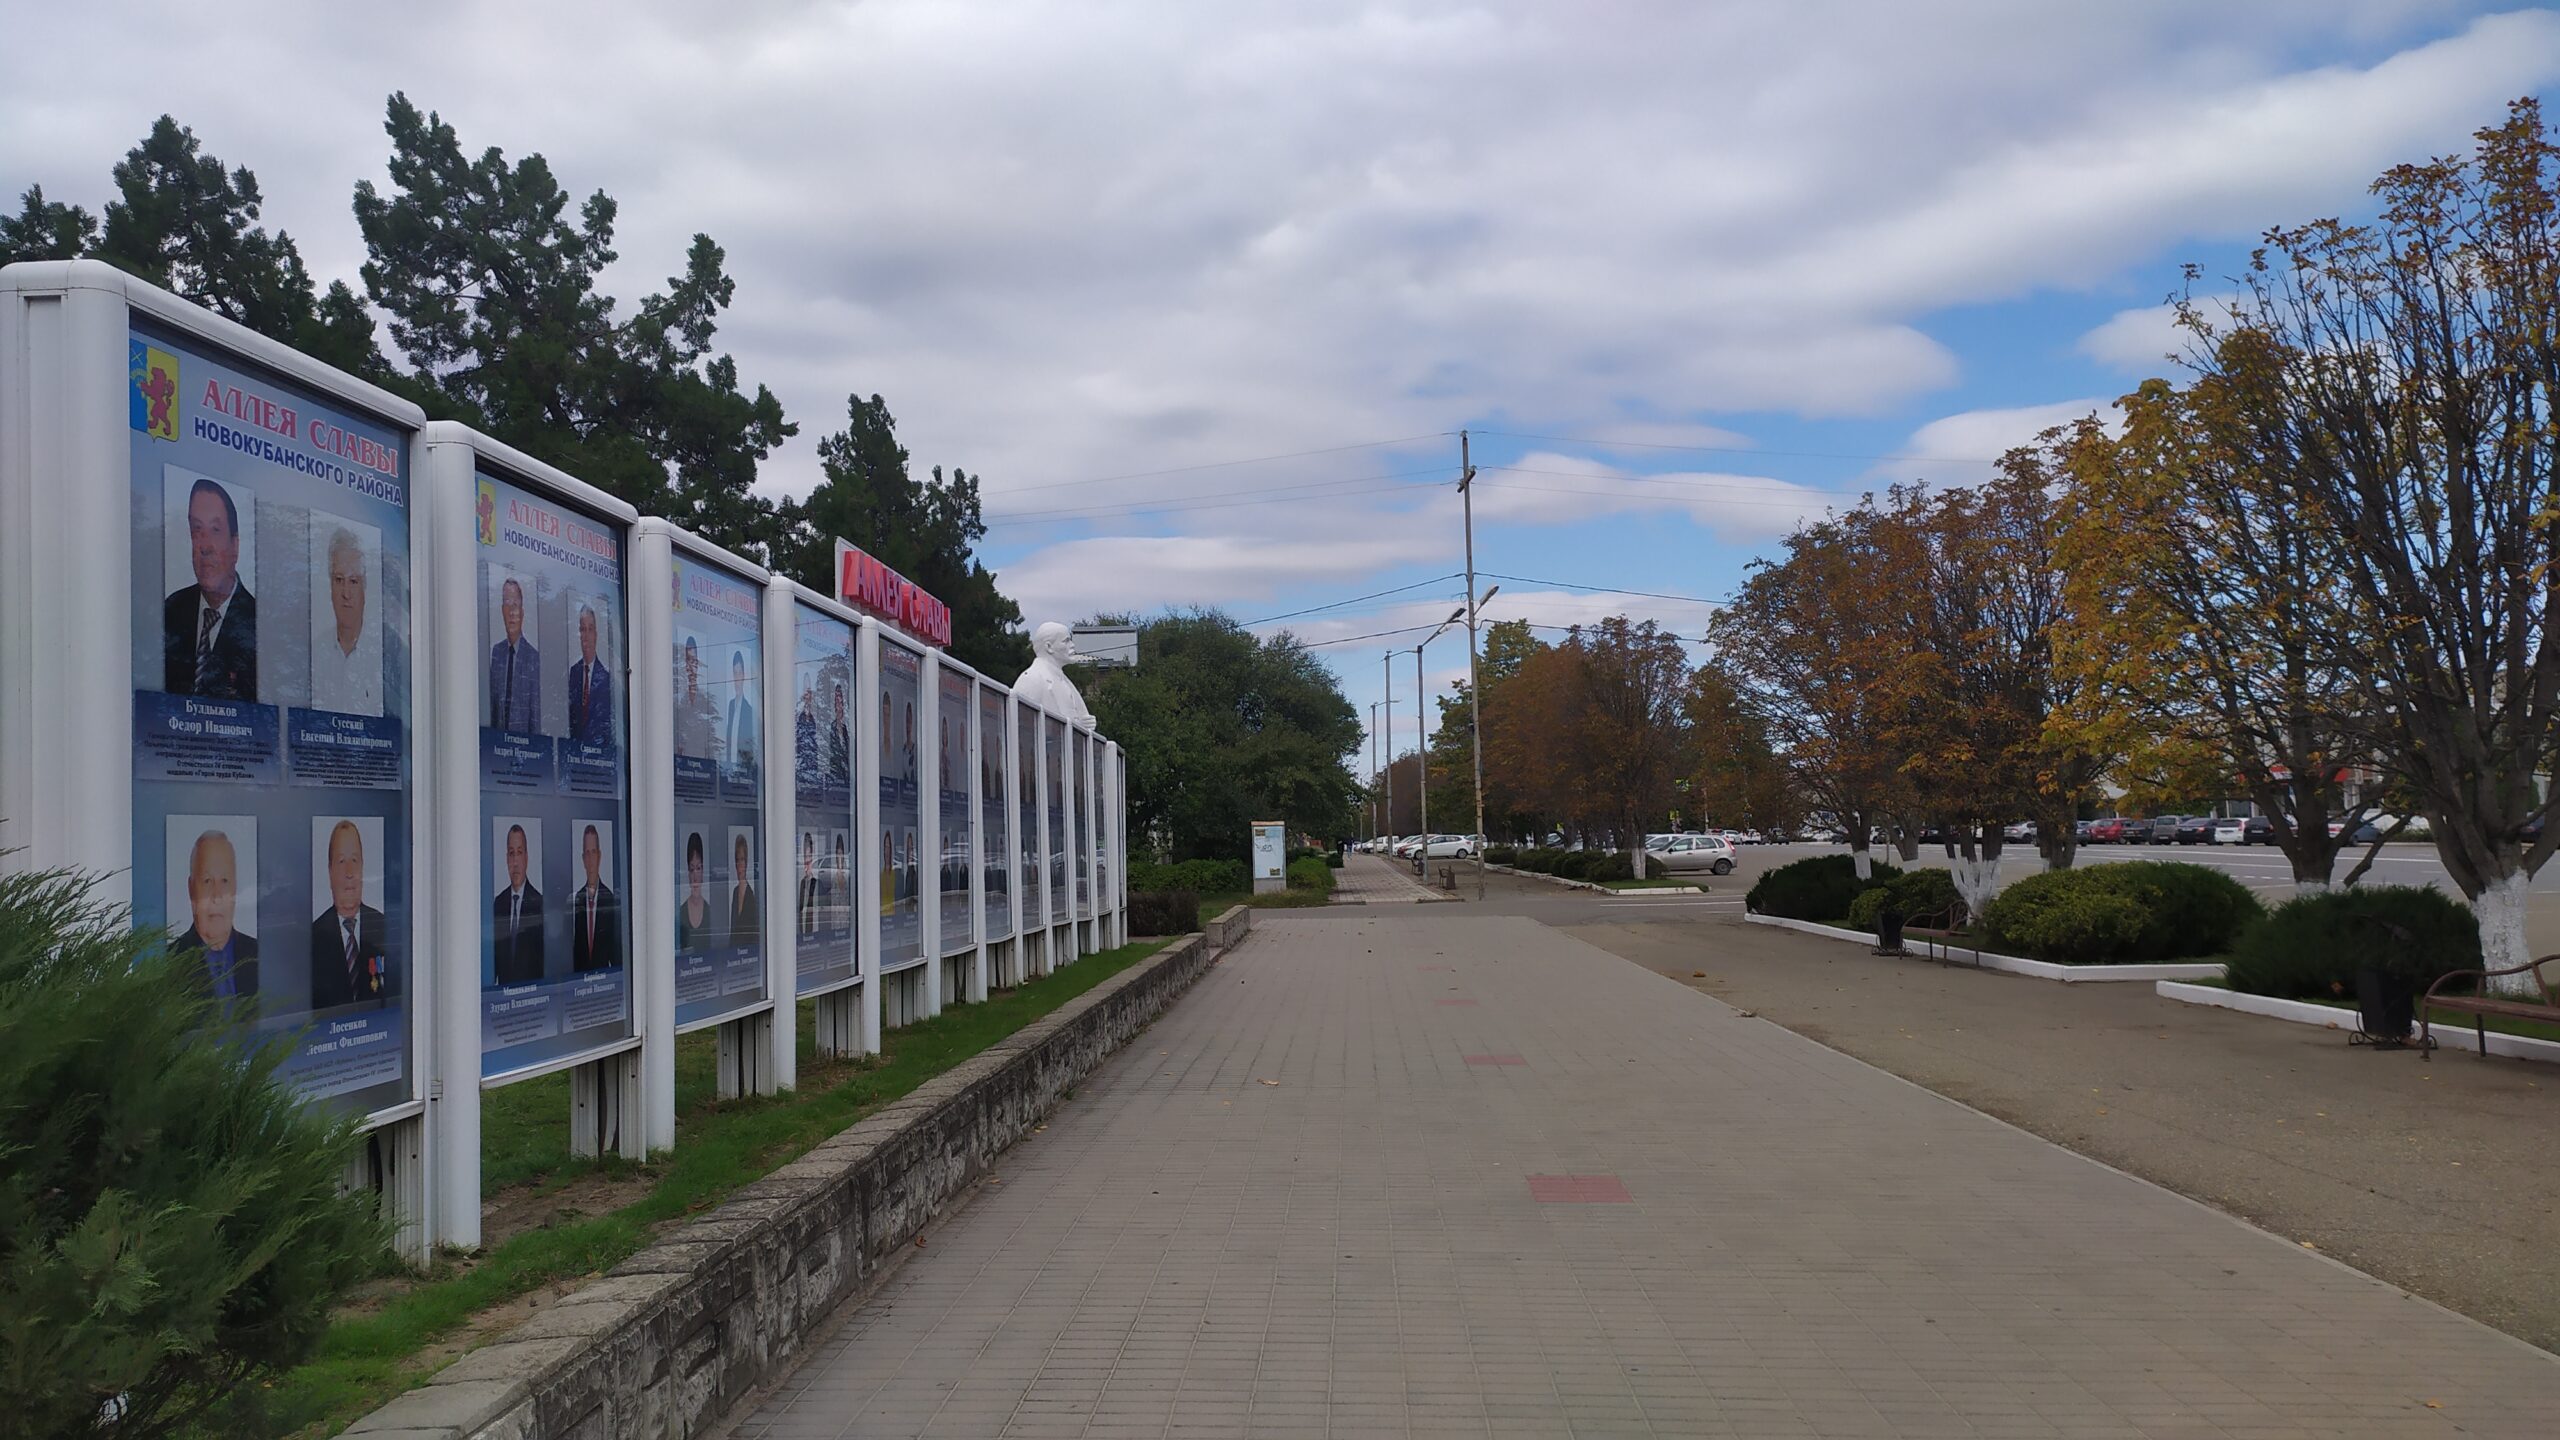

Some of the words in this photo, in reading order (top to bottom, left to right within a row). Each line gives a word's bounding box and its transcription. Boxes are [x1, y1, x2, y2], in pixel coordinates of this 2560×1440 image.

[202, 378, 297, 439] АЛЛЕЯ
[309, 418, 399, 477] СЛАВЫ
[194, 416, 344, 485] НОВОКУБАНСКОГО
[348, 470, 404, 506] РАЙОНА
[508, 498, 560, 538] АЛЛЕЯ
[566, 522, 617, 562] СЛАВЫ
[504, 527, 586, 570] НОВОКУБАНСКОГО
[588, 560, 620, 583] РАЙОНА
[690, 574, 721, 601] АЛЛЕЯ
[843, 550, 903, 621] АЛЛЕЯ
[907, 585, 952, 647] СЛАВЫ
[185, 700, 238, 717] Булдыжов
[168, 716, 202, 735] Федор
[205, 720, 253, 737] Иванович
[300, 729, 335, 744] Евгений
[336, 733, 393, 749] Владимирович
[329, 1019, 367, 1035] Лосенков
[339, 1030, 388, 1049] Филиппович
